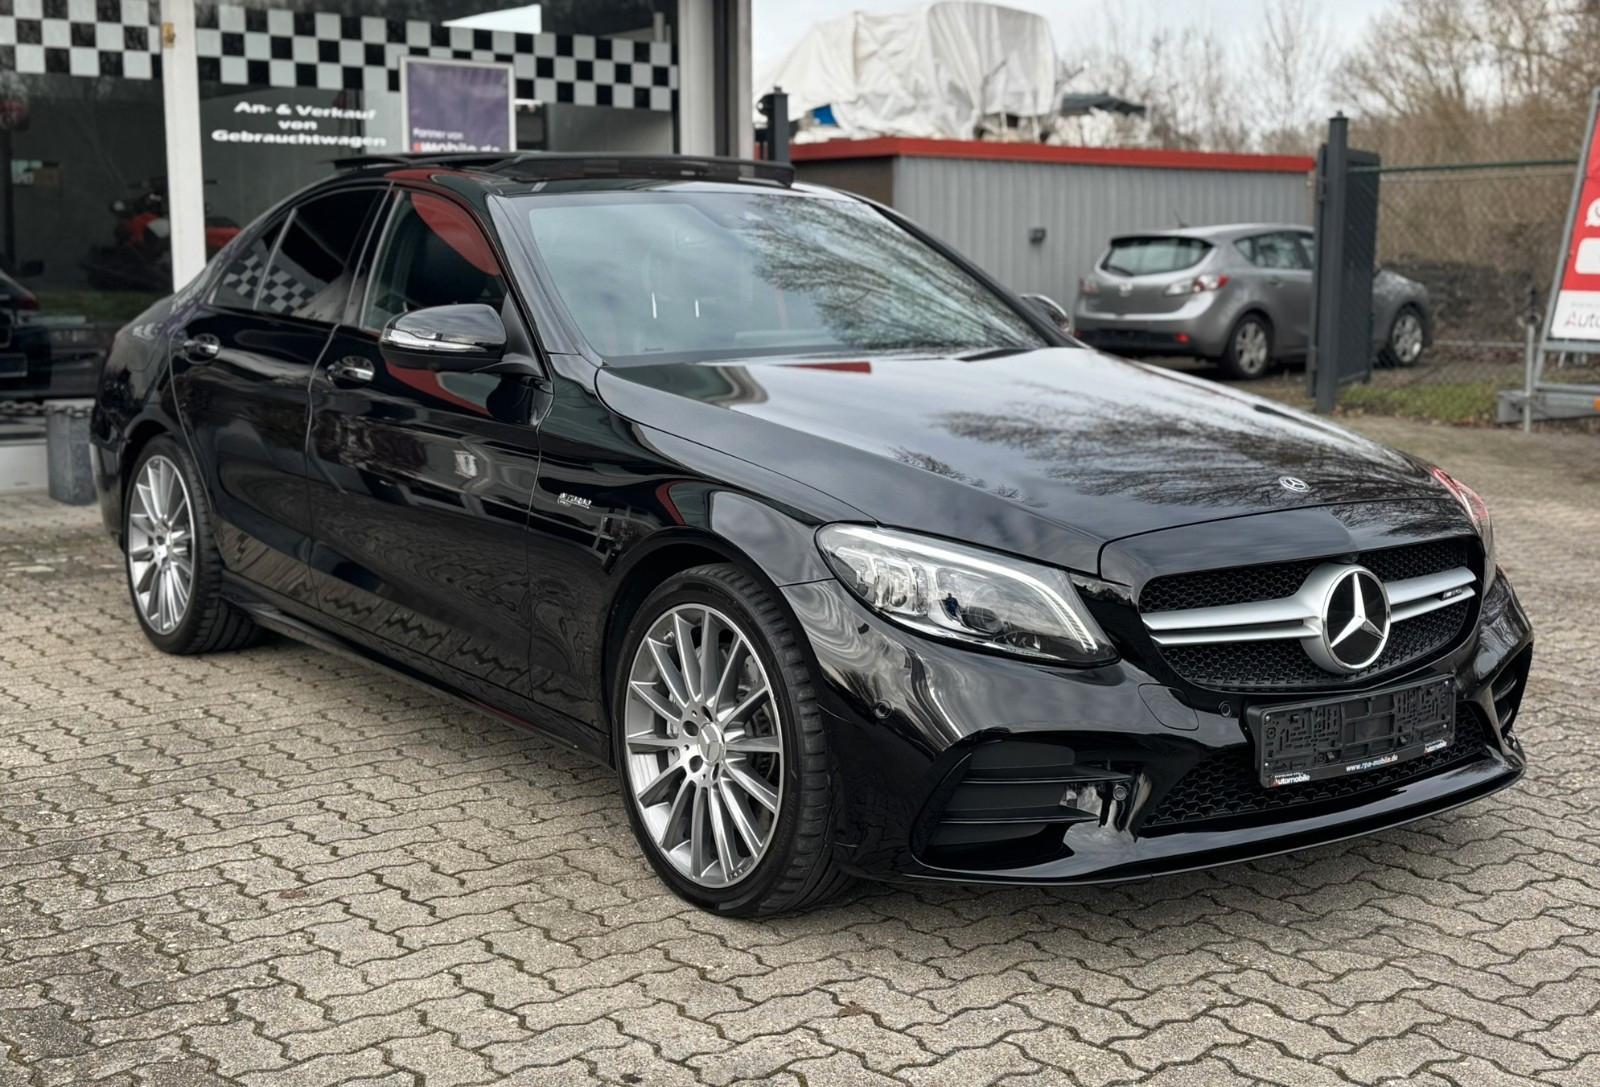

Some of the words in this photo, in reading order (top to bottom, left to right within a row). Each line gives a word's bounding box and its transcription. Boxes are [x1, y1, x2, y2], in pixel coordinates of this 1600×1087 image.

[234, 101, 272, 114] An-
[276, 103, 292, 115] &
[296, 105, 377, 120] Verkauf
[278, 120, 318, 130] von
[211, 129, 388, 148] Gebrauchtwagen
